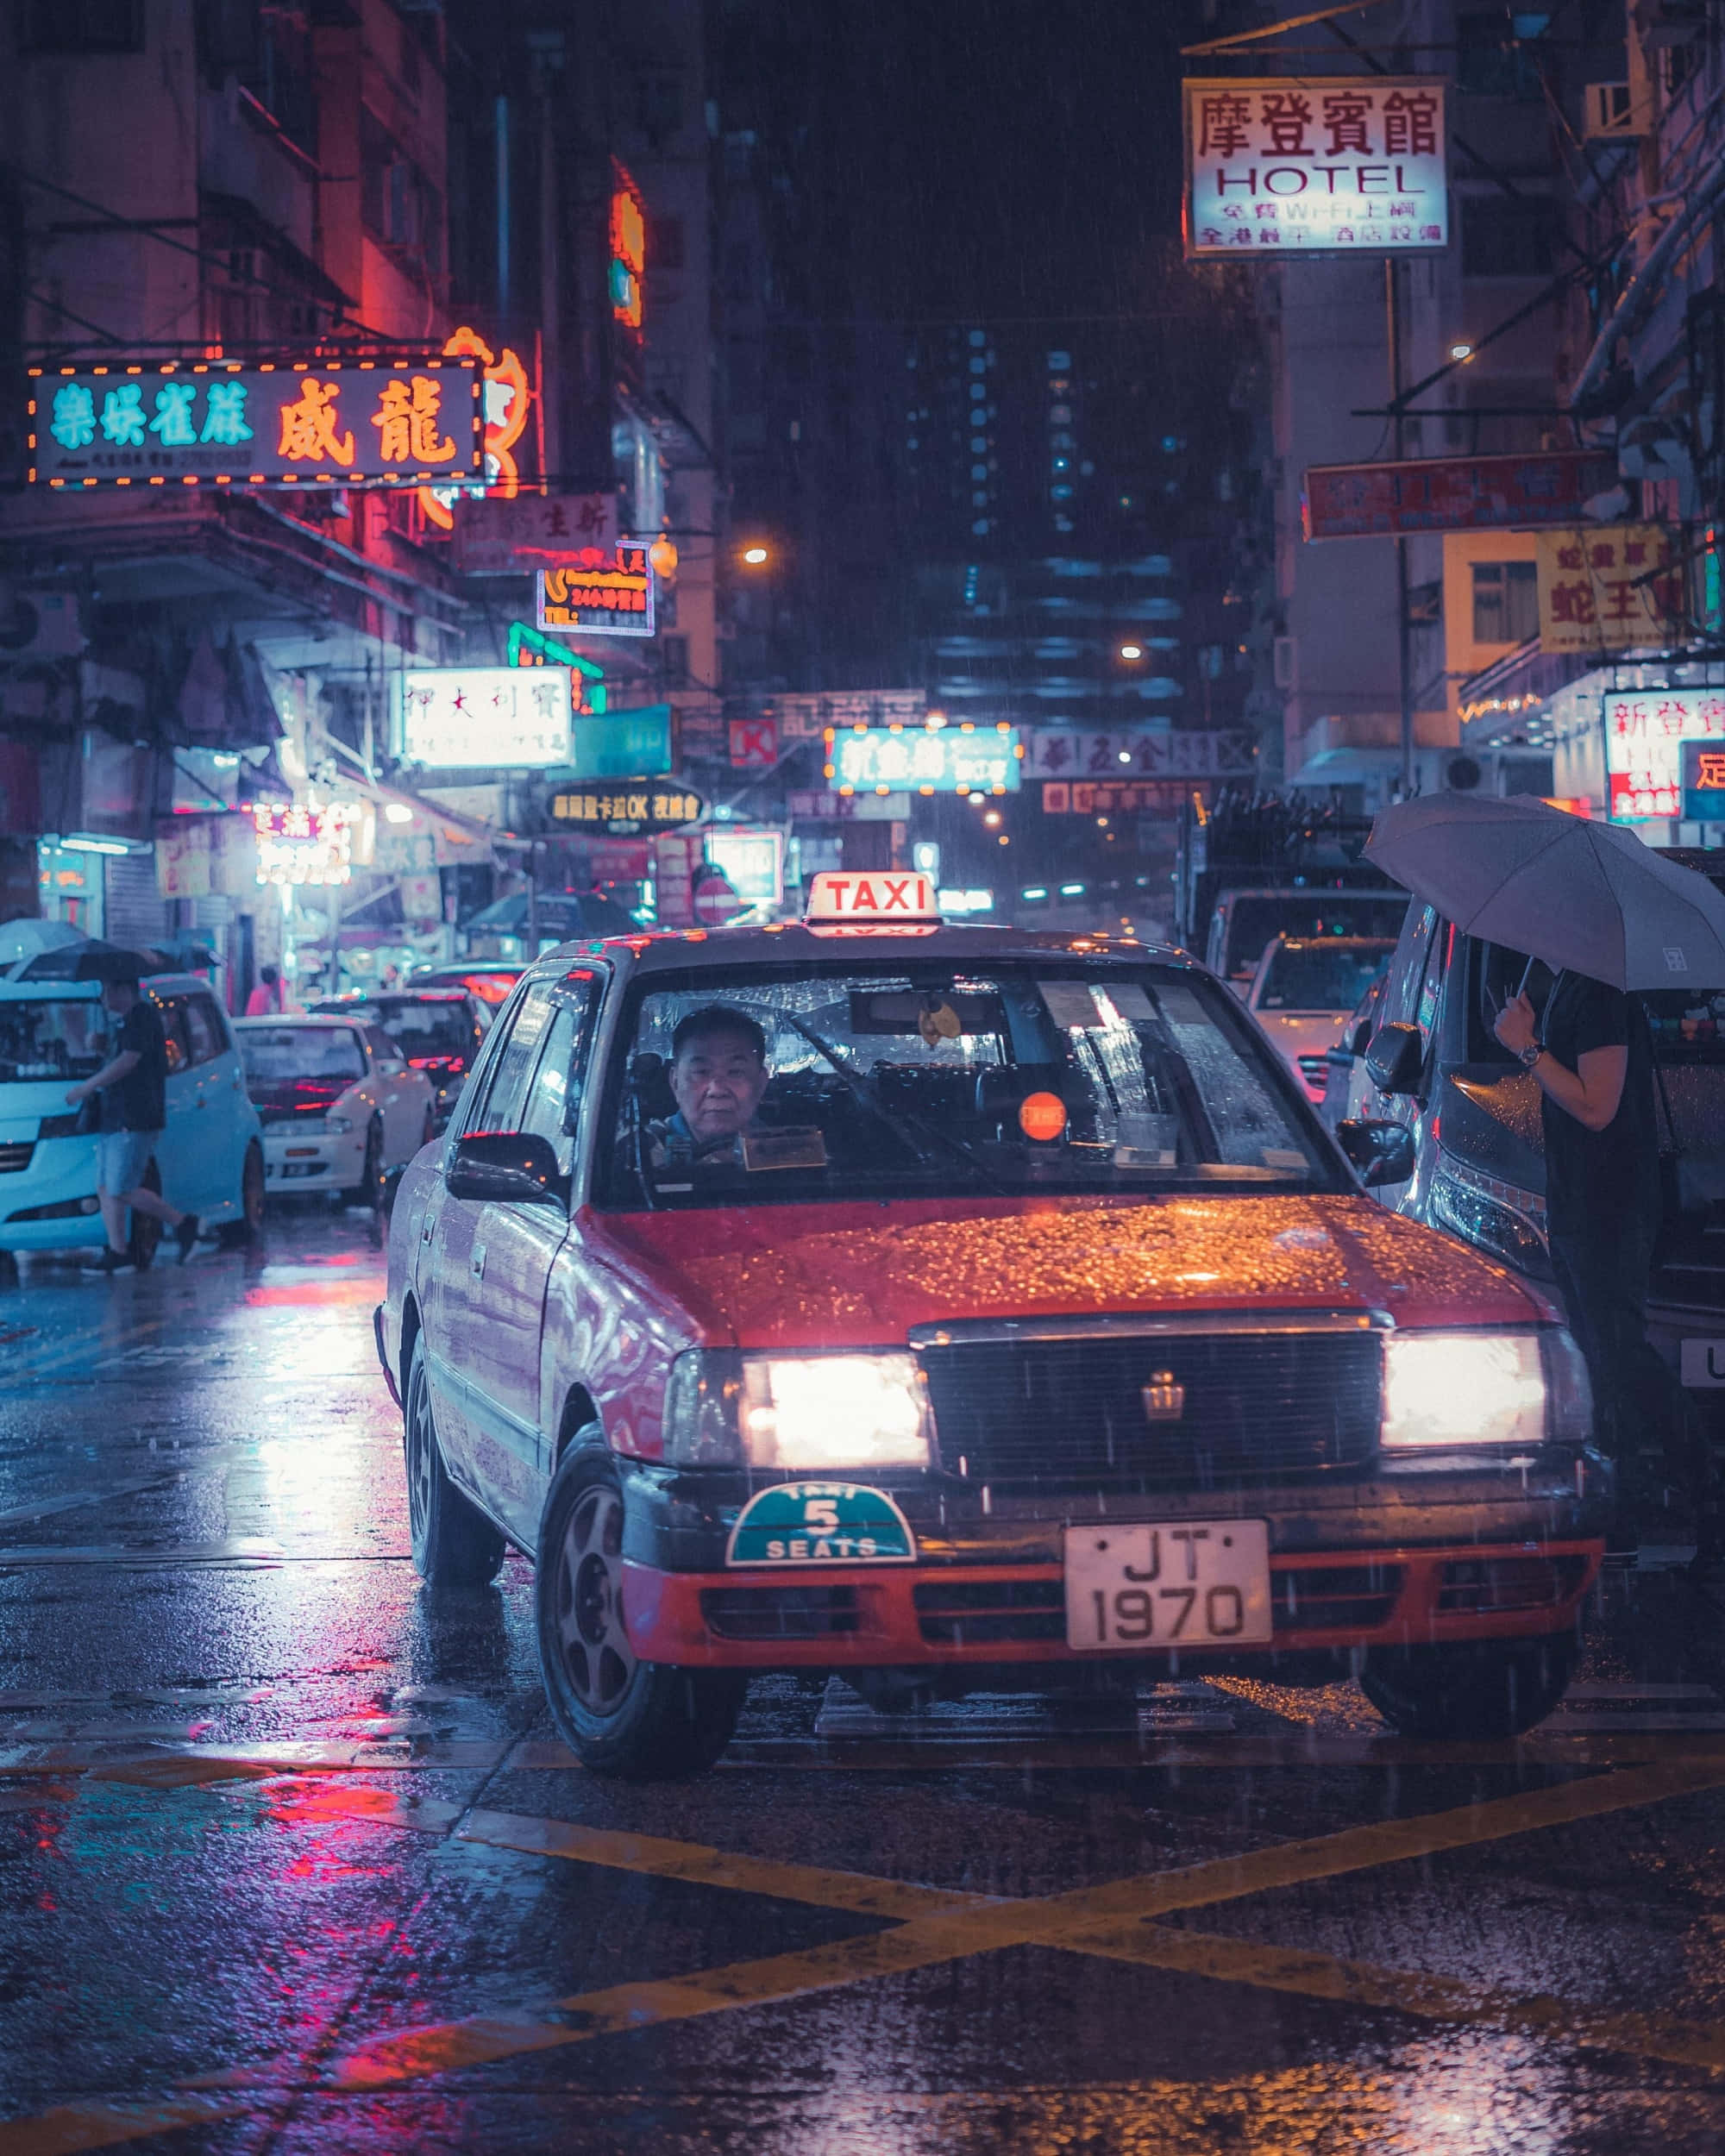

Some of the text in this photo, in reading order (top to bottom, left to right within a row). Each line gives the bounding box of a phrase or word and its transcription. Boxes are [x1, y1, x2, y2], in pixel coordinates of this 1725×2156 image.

[1199, 91, 1437, 159] 摩登賓館
[1216, 166, 1425, 196] HOTEL
[826, 880, 925, 911] TAXI
[804, 1500, 839, 1535] 5
[766, 1538, 876, 1558] SEATS
[1124, 1529, 1210, 1583] JT
[1094, 1585, 1244, 1642] 1970
